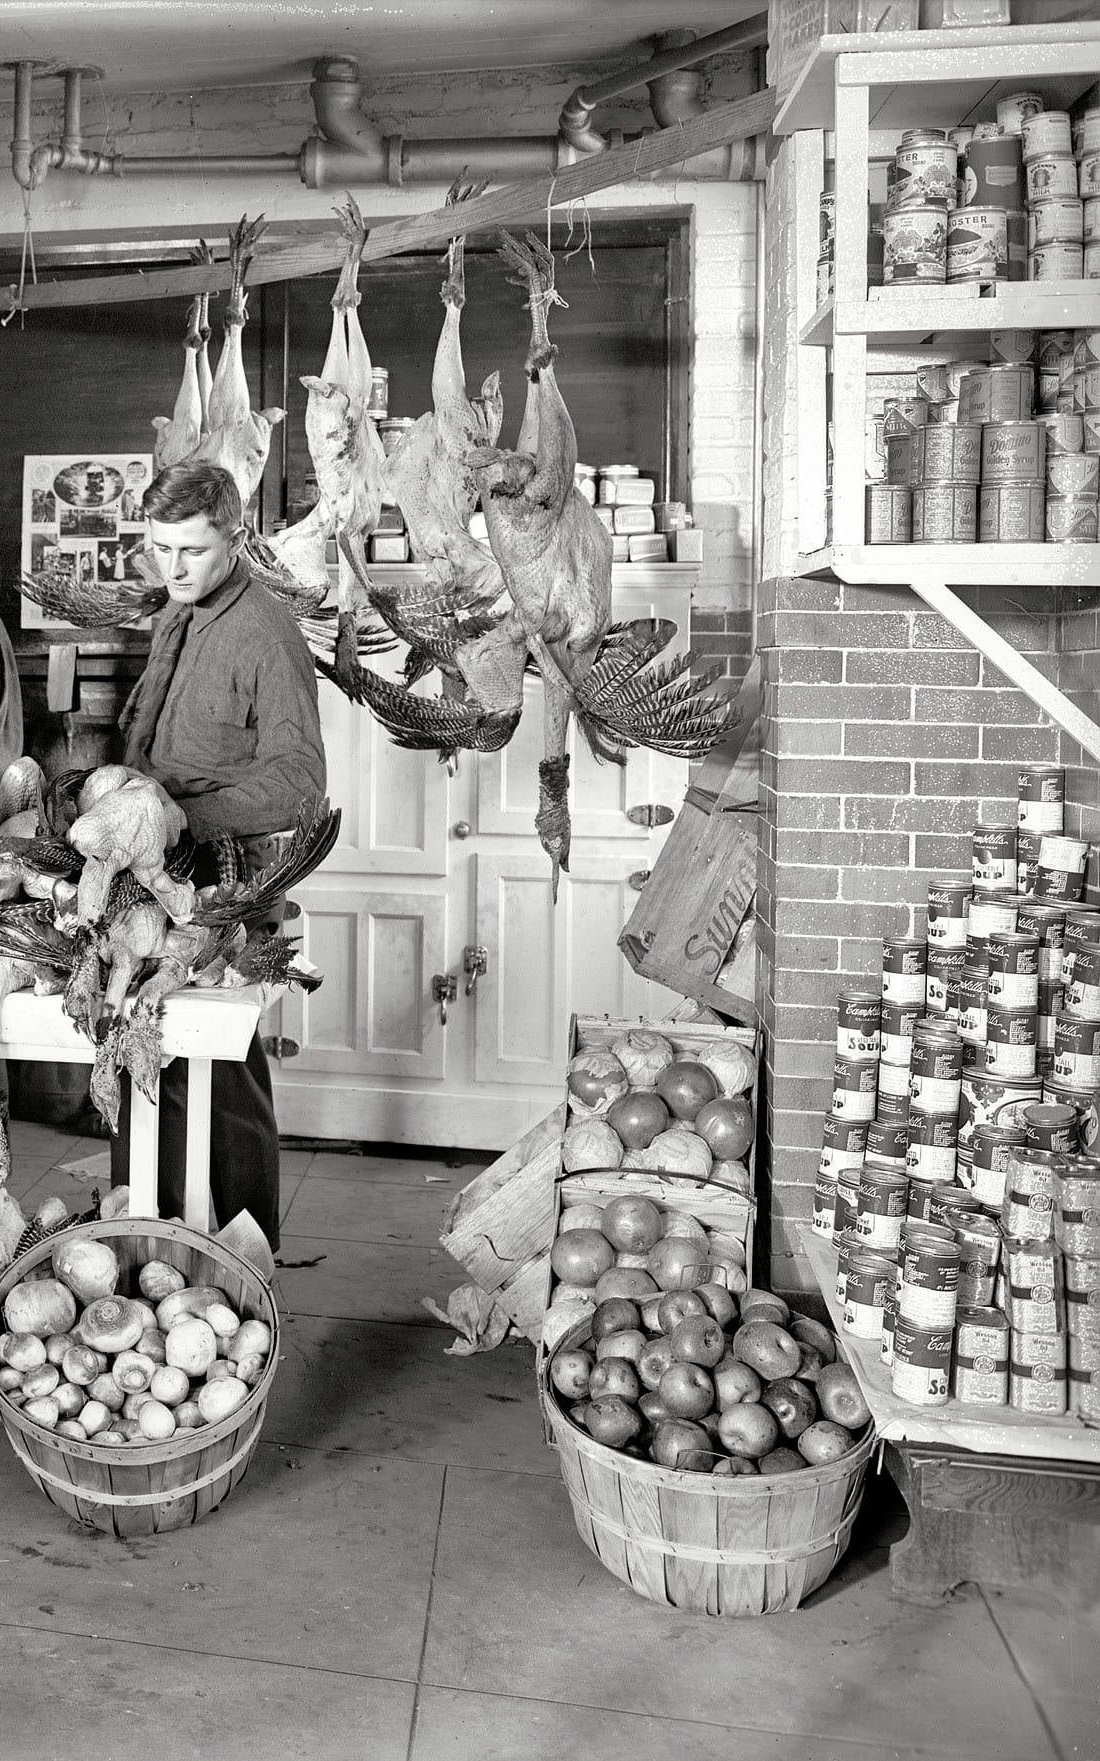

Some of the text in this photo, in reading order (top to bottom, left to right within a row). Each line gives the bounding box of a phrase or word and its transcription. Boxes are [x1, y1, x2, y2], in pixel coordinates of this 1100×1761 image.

[990, 433, 1032, 454] Domino
[1012, 455, 1035, 465] Syrup
[928, 928, 947, 937] UP
[988, 984, 1002, 995] UP
[1064, 994, 1081, 1004] UP
[958, 1018, 978, 1030] UP
[1055, 1065, 1073, 1076] UP
[820, 1158, 831, 1167] UP
[906, 1157, 919, 1167] UP
[812, 1217, 831, 1229] UP
[857, 1223, 872, 1236] UP
[928, 1379, 946, 1395] SO
